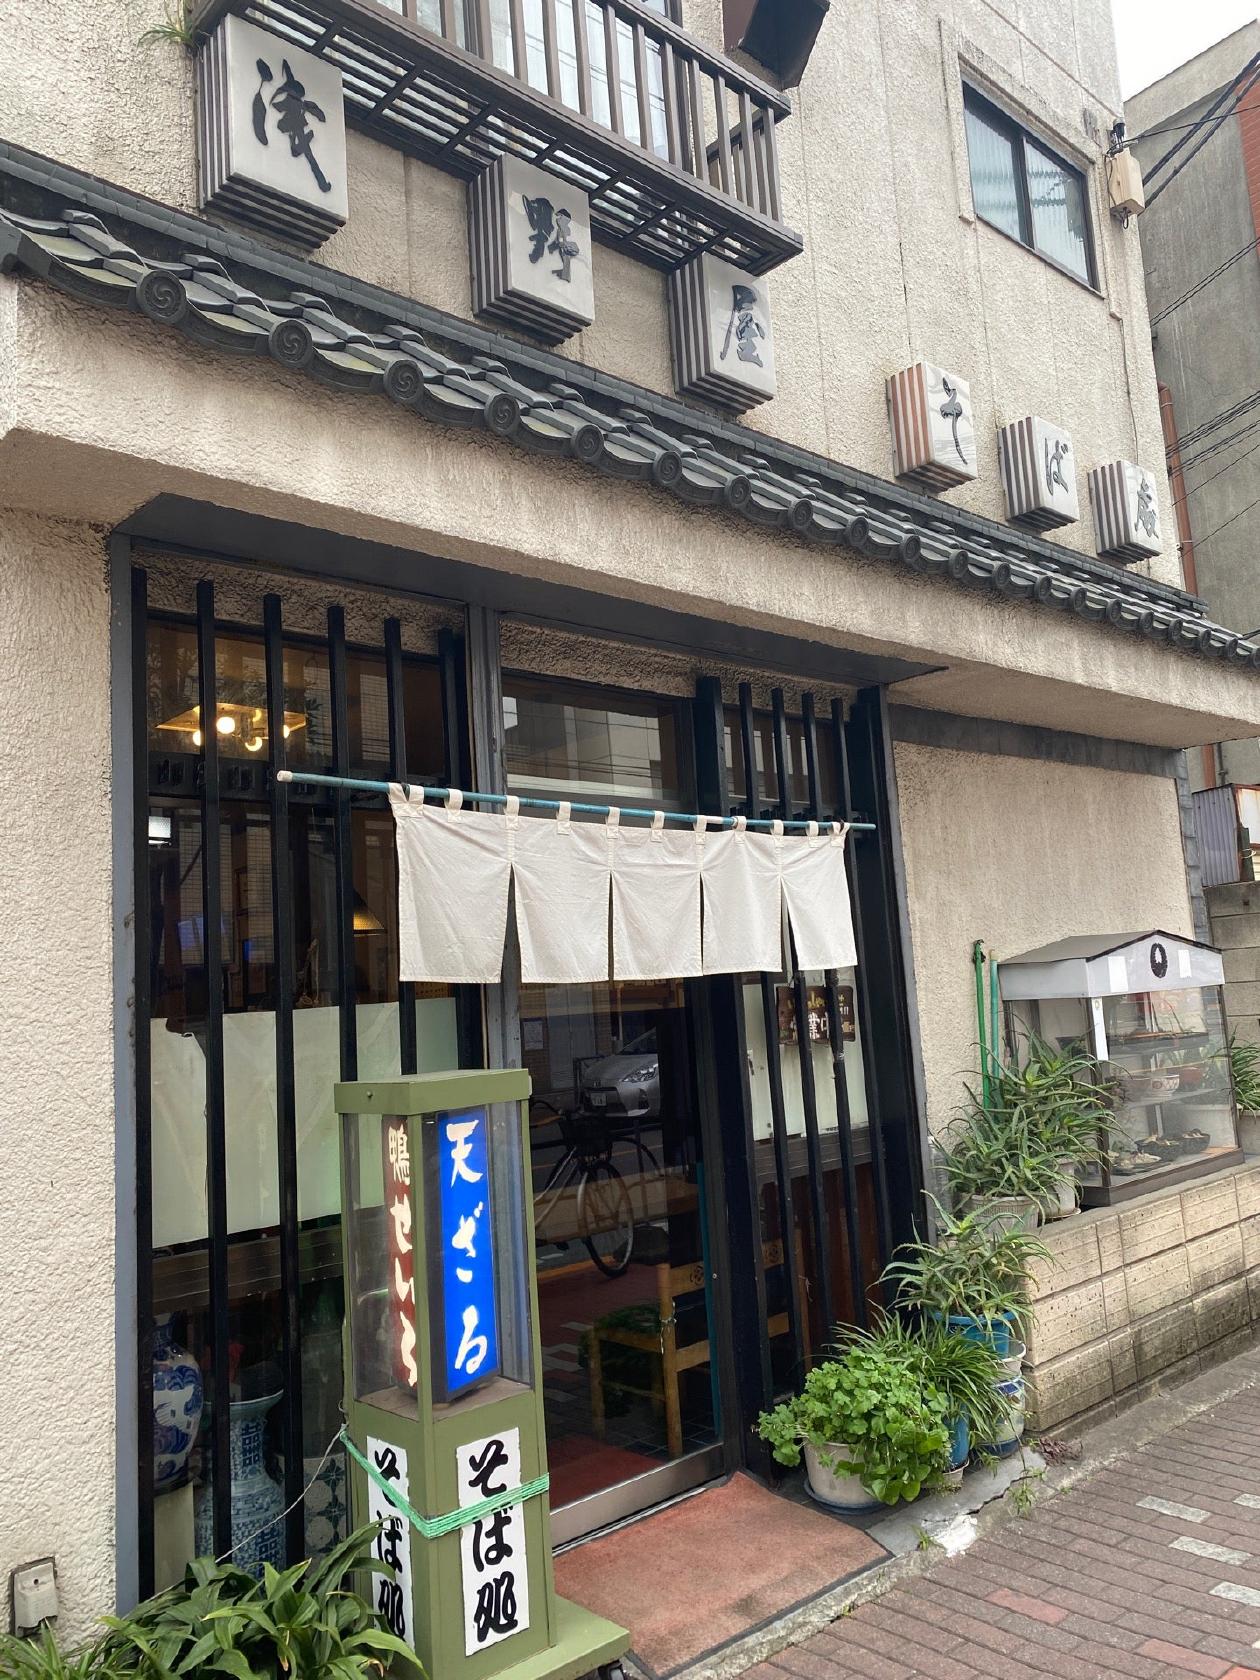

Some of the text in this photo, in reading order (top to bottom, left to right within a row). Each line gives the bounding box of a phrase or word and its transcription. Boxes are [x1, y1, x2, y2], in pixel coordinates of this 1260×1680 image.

[720, 285, 765, 367] 屋
[446, 1119, 488, 1374] 天ざる
[468, 1439, 519, 1642] そば処
